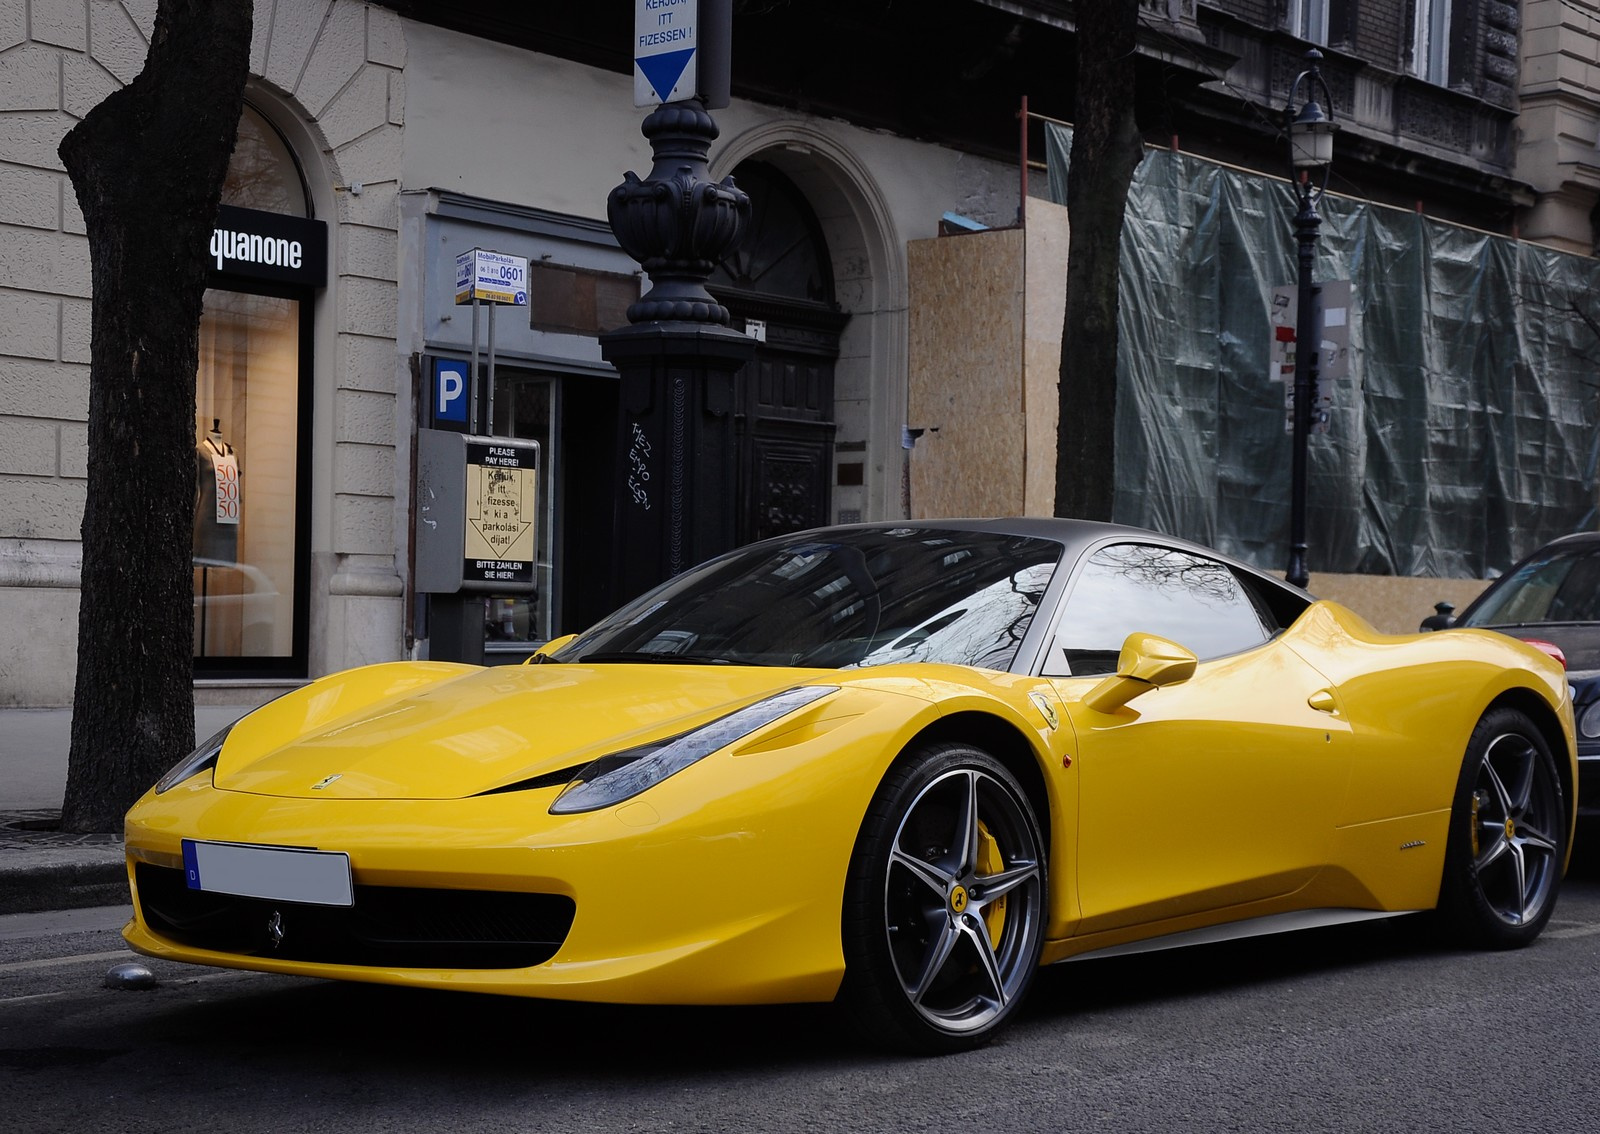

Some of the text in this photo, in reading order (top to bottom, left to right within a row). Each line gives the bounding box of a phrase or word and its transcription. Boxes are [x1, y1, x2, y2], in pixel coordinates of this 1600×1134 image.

[658, 12, 673, 26] ITT
[640, 28, 686, 47] FIZESSEN
[500, 266, 522, 281] 0601
[439, 370, 463, 413] P
[489, 447, 516, 457] PLEASE
[485, 456, 519, 467] PAY HERE!
[217, 464, 236, 482] 50
[218, 482, 237, 501] 50
[497, 484, 506, 494] itt
[487, 496, 516, 507] fizesse
[218, 500, 238, 519] 50
[494, 509, 508, 519] ki a
[482, 522, 519, 533] parkolási
[476, 560, 523, 570] BITTE ZAHLEN
[484, 570, 514, 580] SIE HIER!
[190, 870, 196, 880] D
